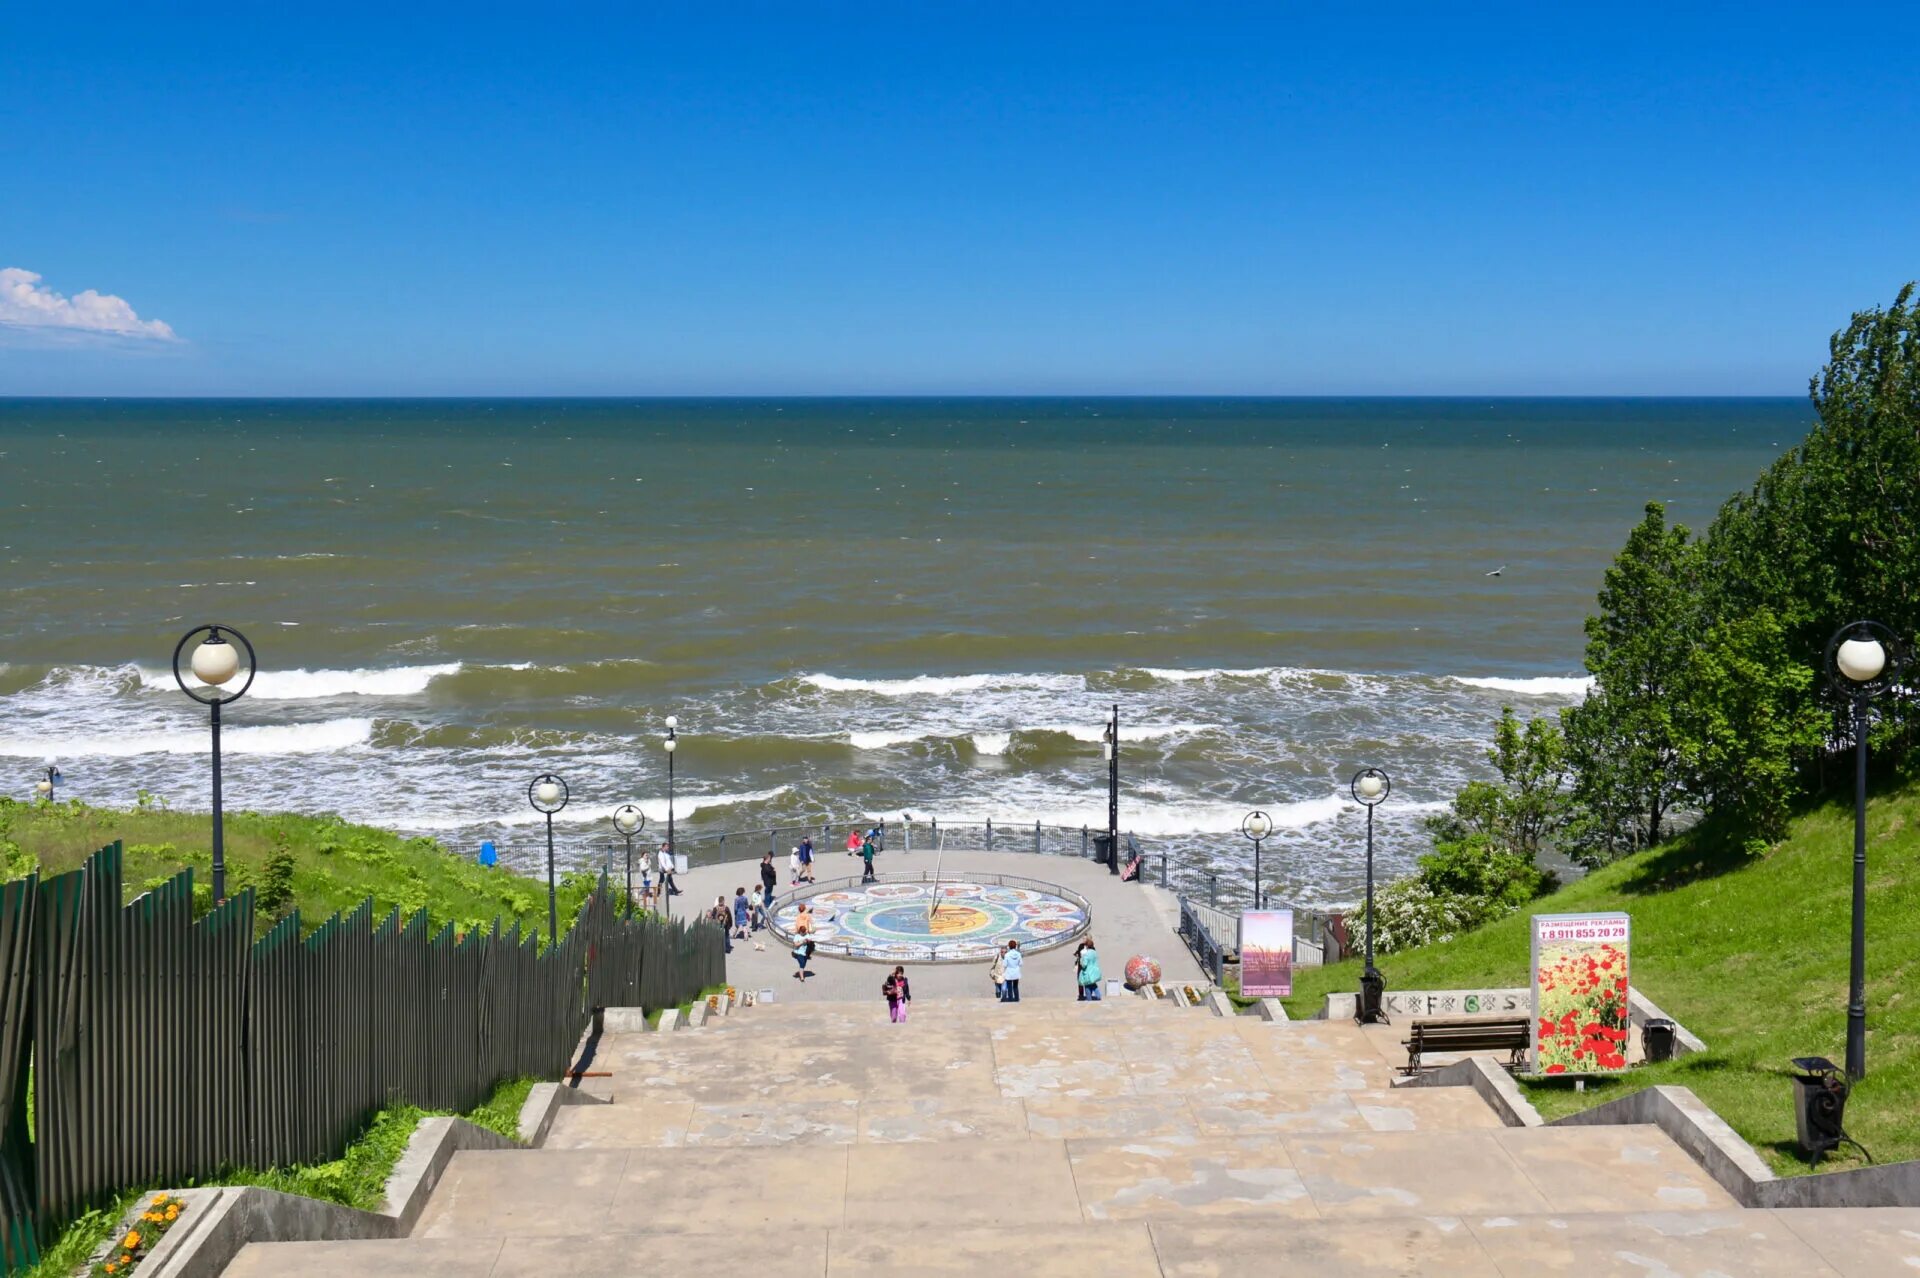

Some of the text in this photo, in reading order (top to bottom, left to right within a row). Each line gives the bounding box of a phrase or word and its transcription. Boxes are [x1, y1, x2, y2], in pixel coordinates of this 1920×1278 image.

[1549, 930, 1555, 939] 8
[1558, 930, 1573, 938] 911
[1576, 929, 1595, 938] 855
[1598, 928, 1610, 937] 20
[1613, 928, 1625, 936] 29
